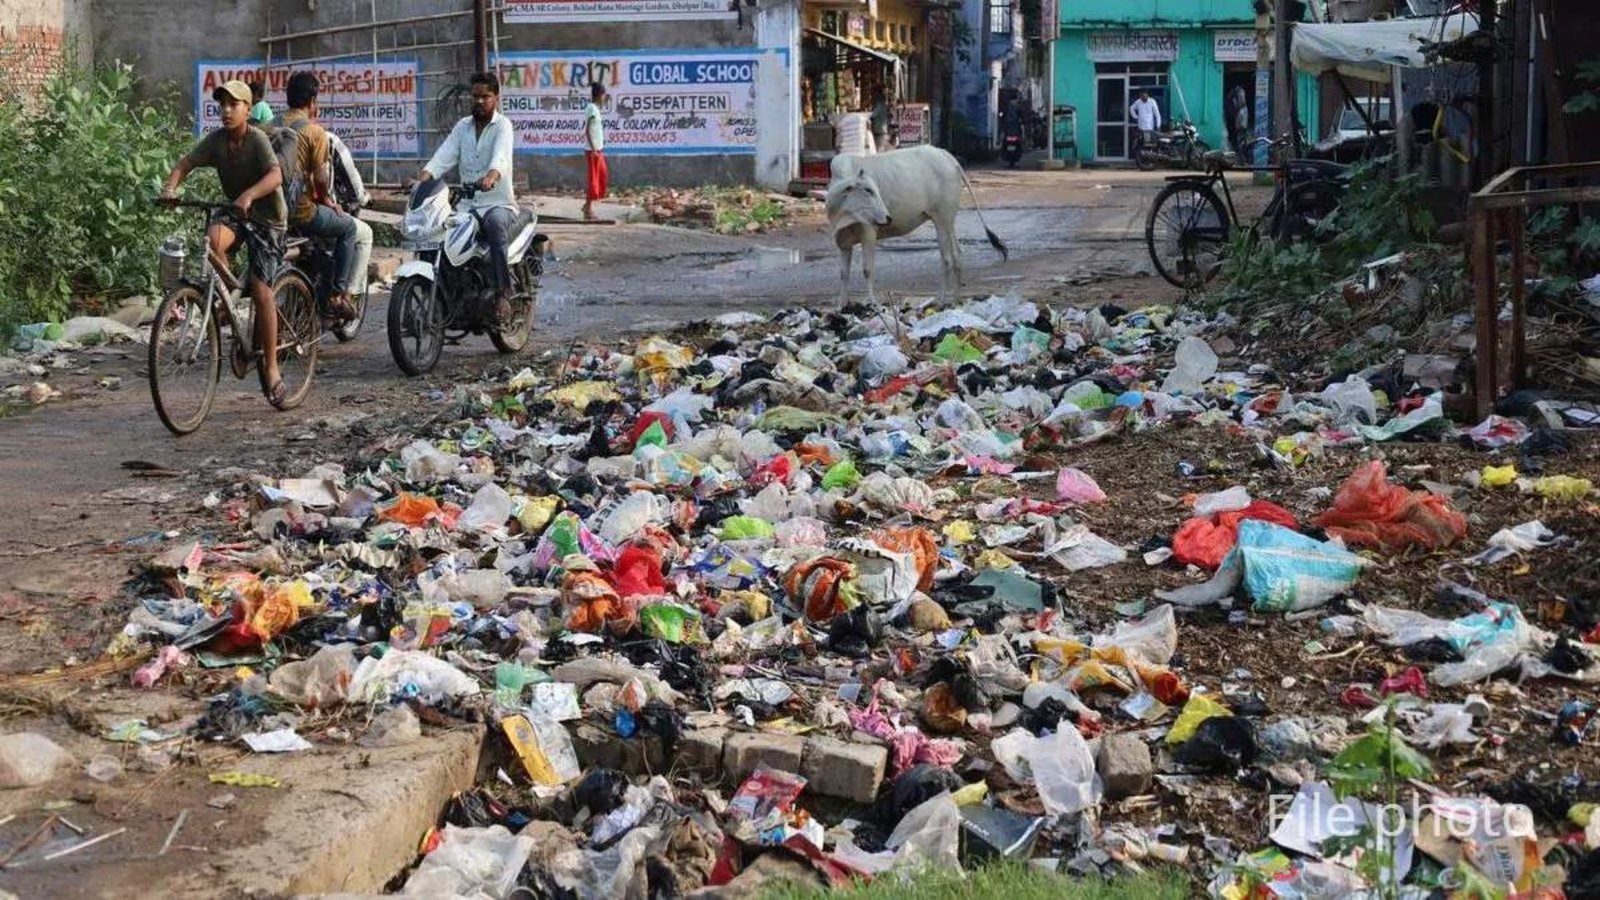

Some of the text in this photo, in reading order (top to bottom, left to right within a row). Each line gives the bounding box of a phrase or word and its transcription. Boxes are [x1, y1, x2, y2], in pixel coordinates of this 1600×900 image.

[1217, 38, 1249, 47] DTDC
[632, 64, 690, 82] GLOBAL
[664, 95, 726, 110] PATTERN
